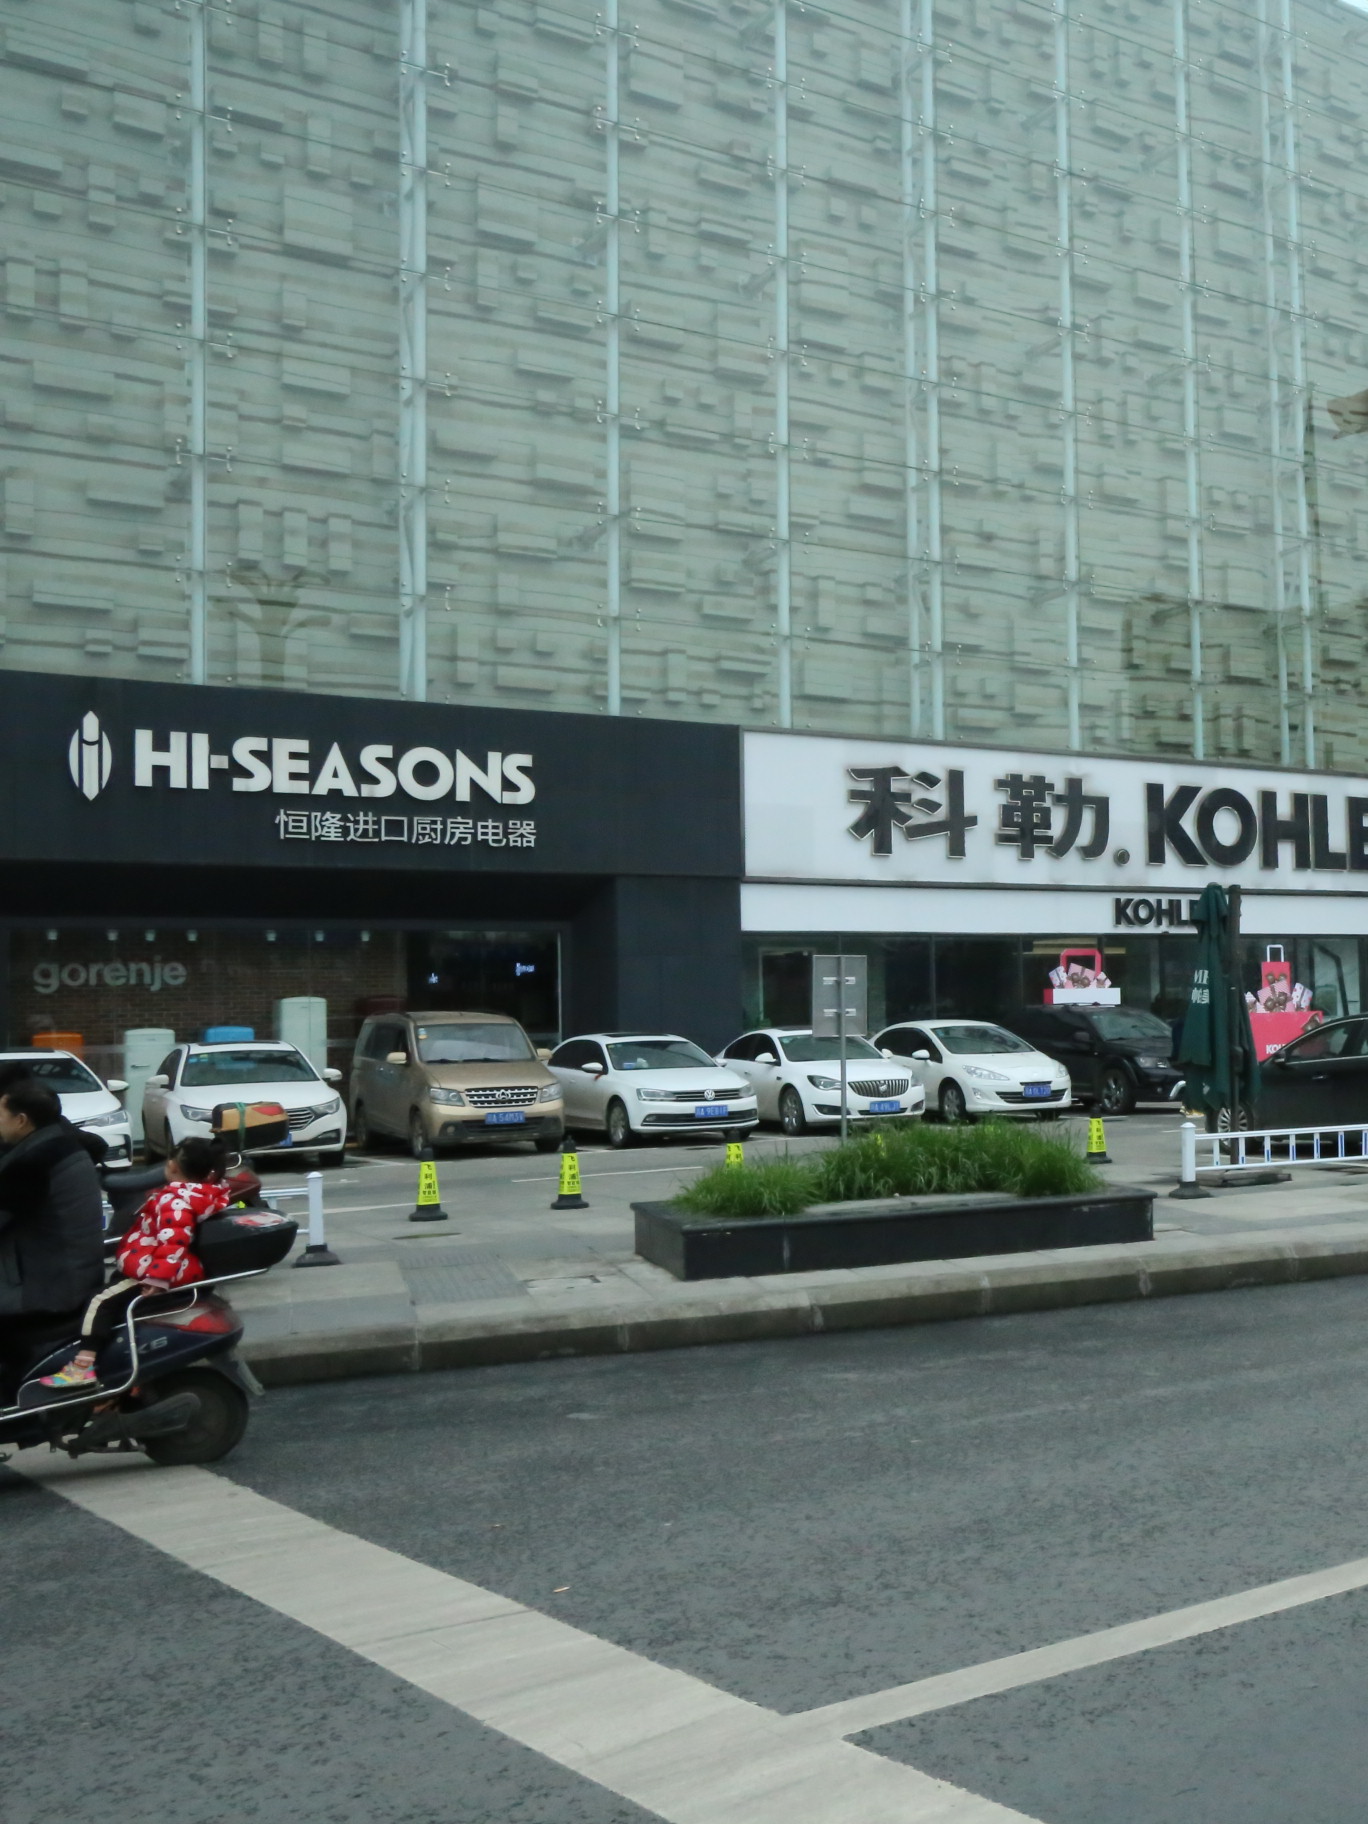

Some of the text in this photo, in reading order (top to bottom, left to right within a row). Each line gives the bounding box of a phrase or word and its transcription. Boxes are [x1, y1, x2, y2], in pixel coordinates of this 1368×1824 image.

[135, 729, 535, 804] HI-SEASONS
[275, 808, 537, 848] 恒隆进口厨房电器
[32, 954, 187, 994] gorenje
